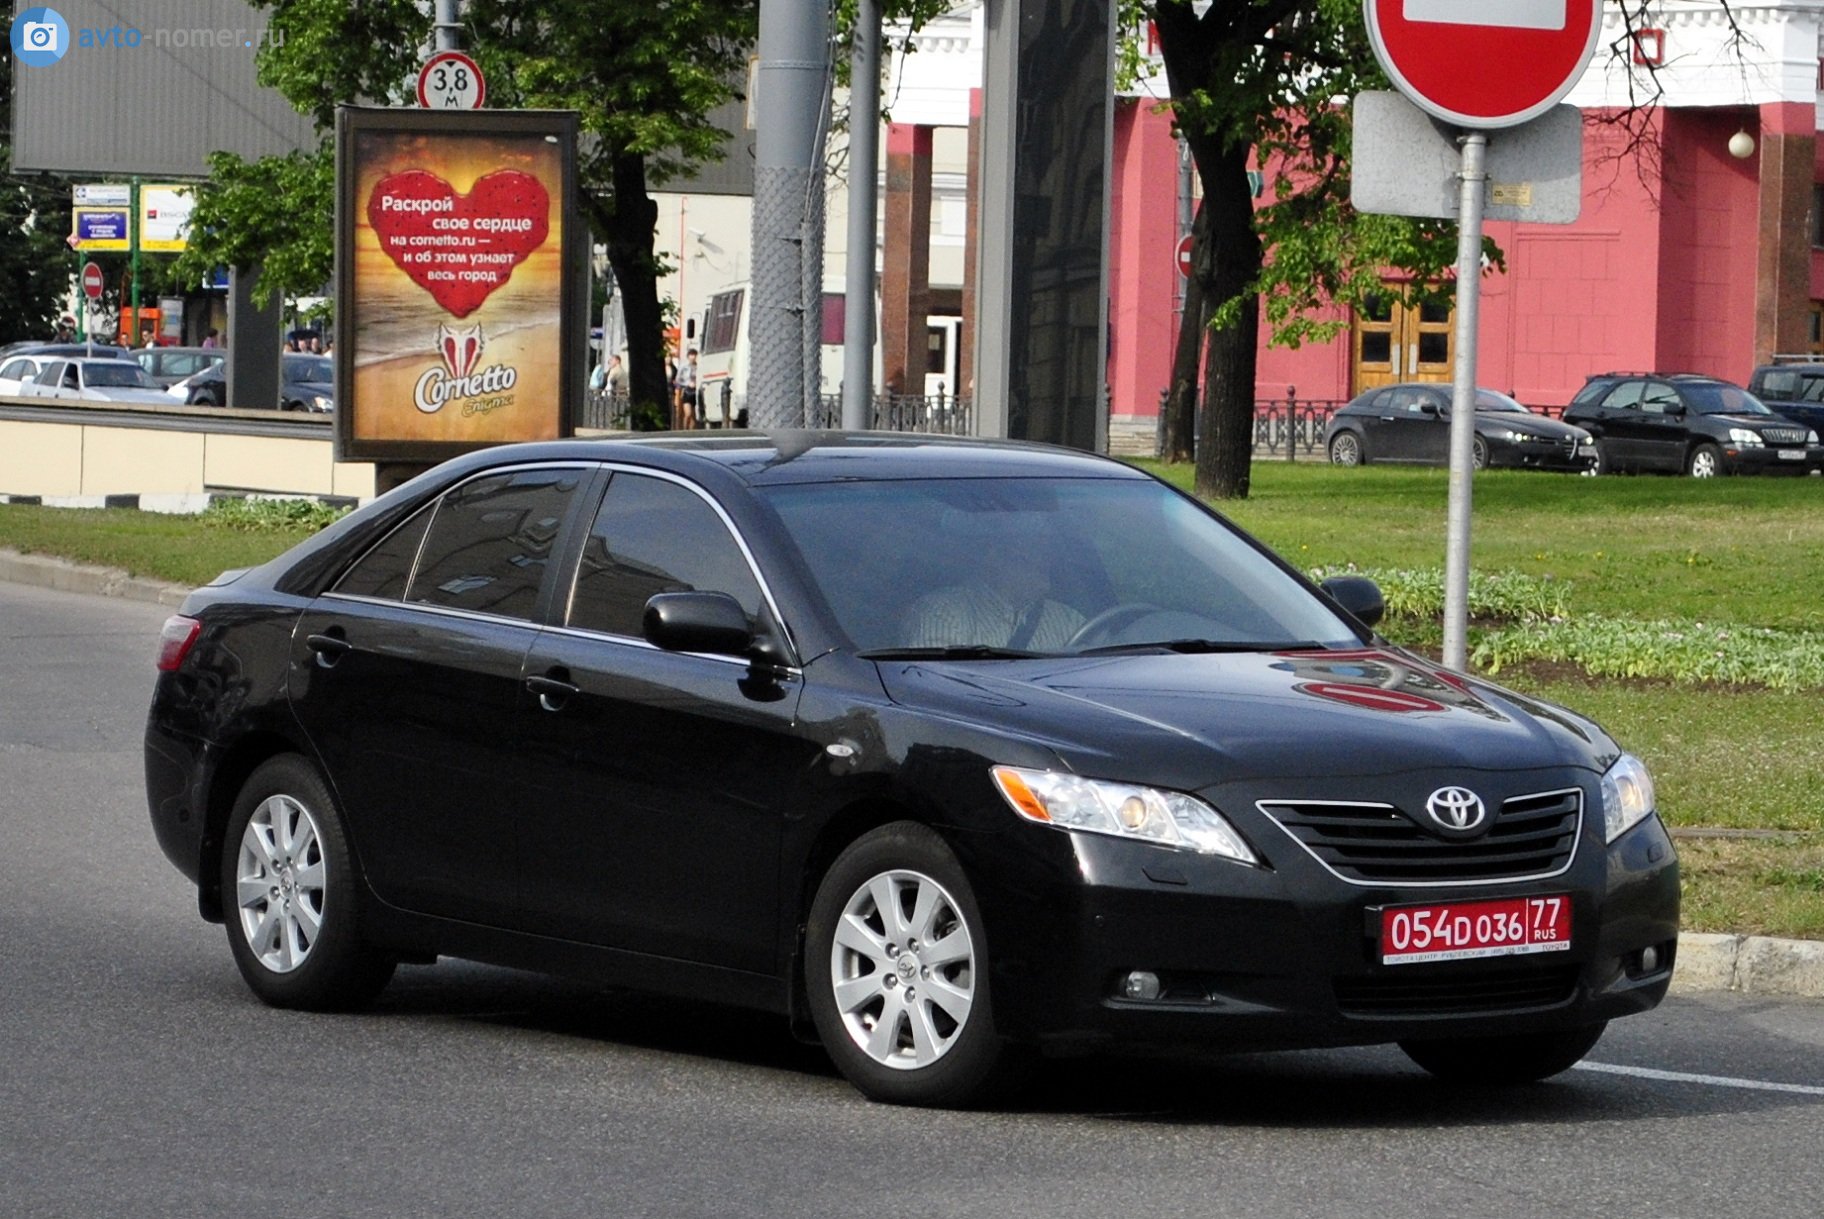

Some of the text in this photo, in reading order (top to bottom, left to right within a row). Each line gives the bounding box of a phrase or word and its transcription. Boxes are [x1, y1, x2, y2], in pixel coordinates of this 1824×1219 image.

[433, 68, 468, 95] 3,8
[381, 195, 453, 214] Раскрой
[432, 217, 532, 233] свое сердце
[390, 236, 406, 246] на
[409, 234, 476, 247] cornetto.ru
[403, 250, 514, 267] и об этом узнает
[427, 271, 497, 283] весь город
[413, 364, 518, 415] Cornetto
[1530, 898, 1561, 929] 77
[1534, 928, 1557, 940] RUS
